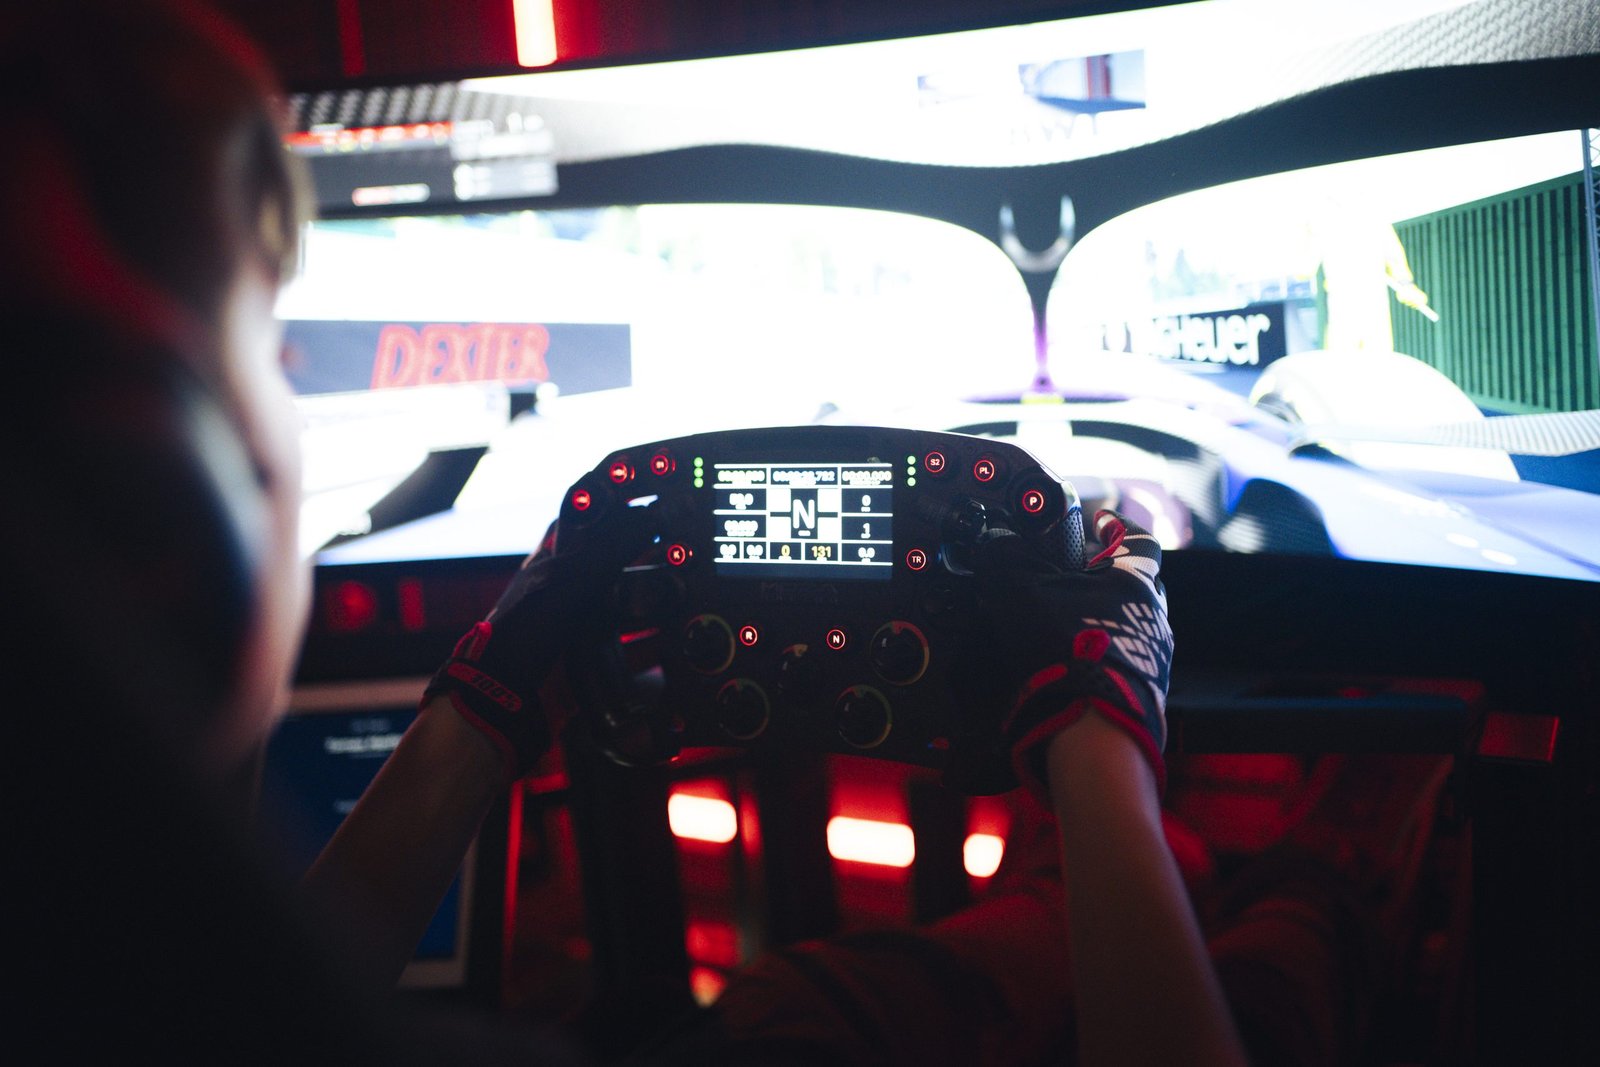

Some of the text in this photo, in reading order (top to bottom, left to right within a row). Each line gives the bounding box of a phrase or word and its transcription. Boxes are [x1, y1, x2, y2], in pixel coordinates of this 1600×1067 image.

[370, 322, 551, 389] DEXTER
[979, 465, 990, 475] PL
[793, 499, 815, 529] N
[781, 544, 790, 556] 0
[811, 545, 832, 558] 131
[910, 554, 923, 564] TR
